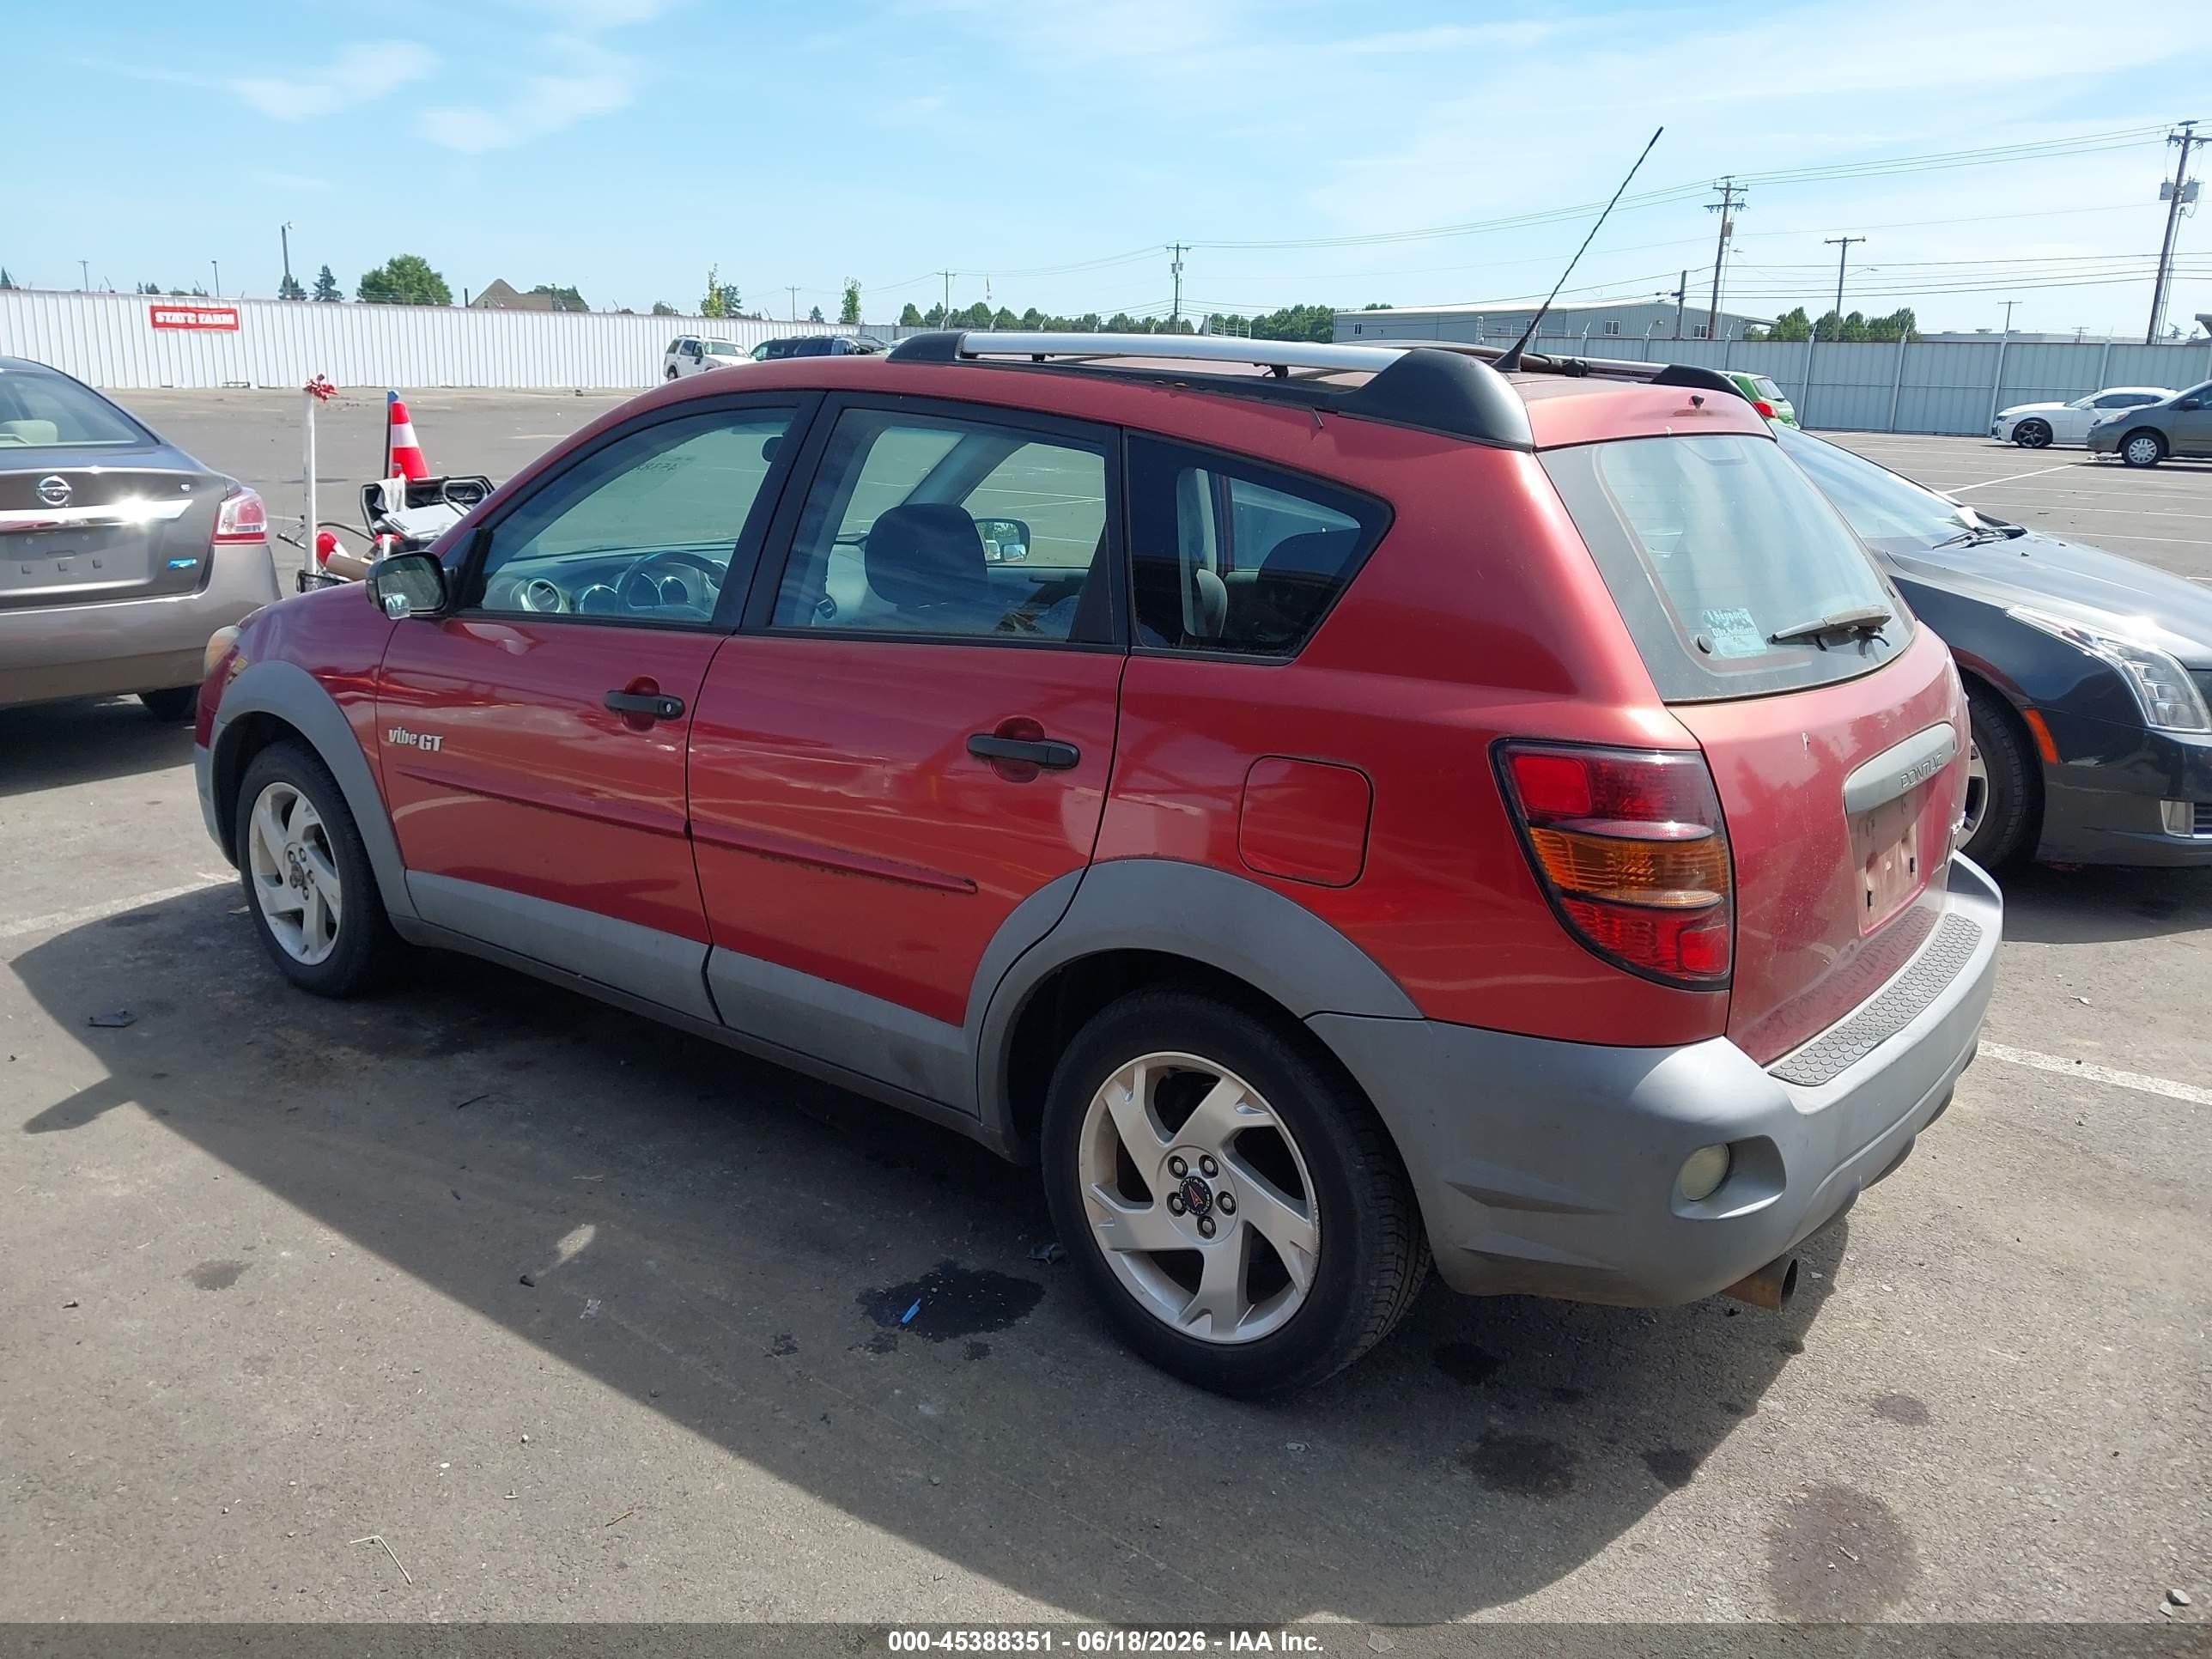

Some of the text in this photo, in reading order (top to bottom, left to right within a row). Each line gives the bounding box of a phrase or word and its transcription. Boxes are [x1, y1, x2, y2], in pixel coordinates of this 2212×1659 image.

[198, 313, 235, 325] FARM
[418, 734, 445, 752] GT
[1899, 752, 1943, 789] PONTIAC
